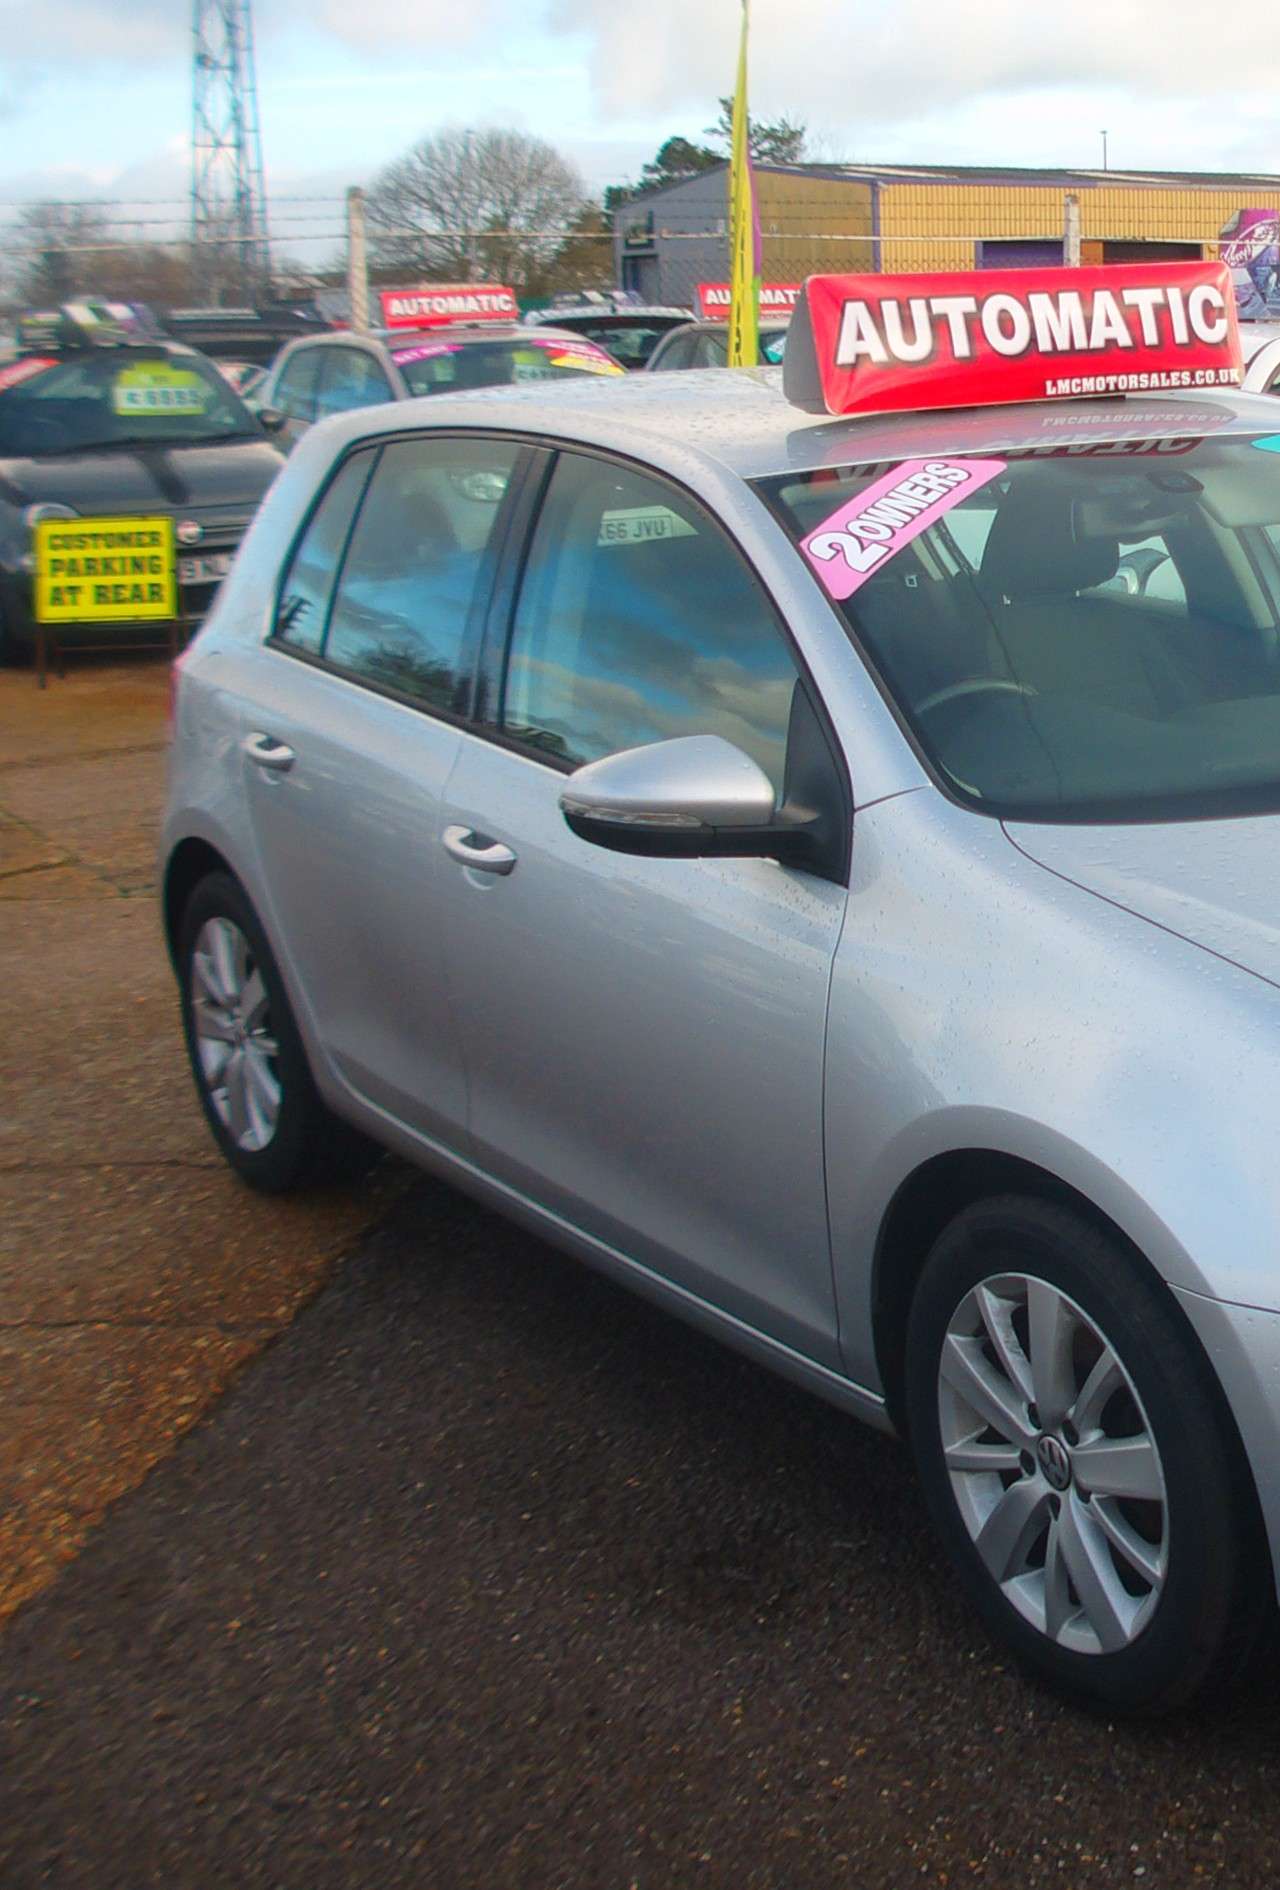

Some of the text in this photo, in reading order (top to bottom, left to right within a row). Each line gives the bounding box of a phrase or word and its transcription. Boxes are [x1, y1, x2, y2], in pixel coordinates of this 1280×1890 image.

[390, 294, 513, 316] AUTOMATIC
[835, 285, 1229, 367] AUTOMATIC
[1045, 368, 1240, 395] LMCMOTORSALES.CO.UK
[808, 463, 972, 574] 2 OWNERS
[48, 531, 162, 551] CUSTOMER
[49, 555, 162, 578] PARKING
[49, 582, 163, 607] AT REAR
